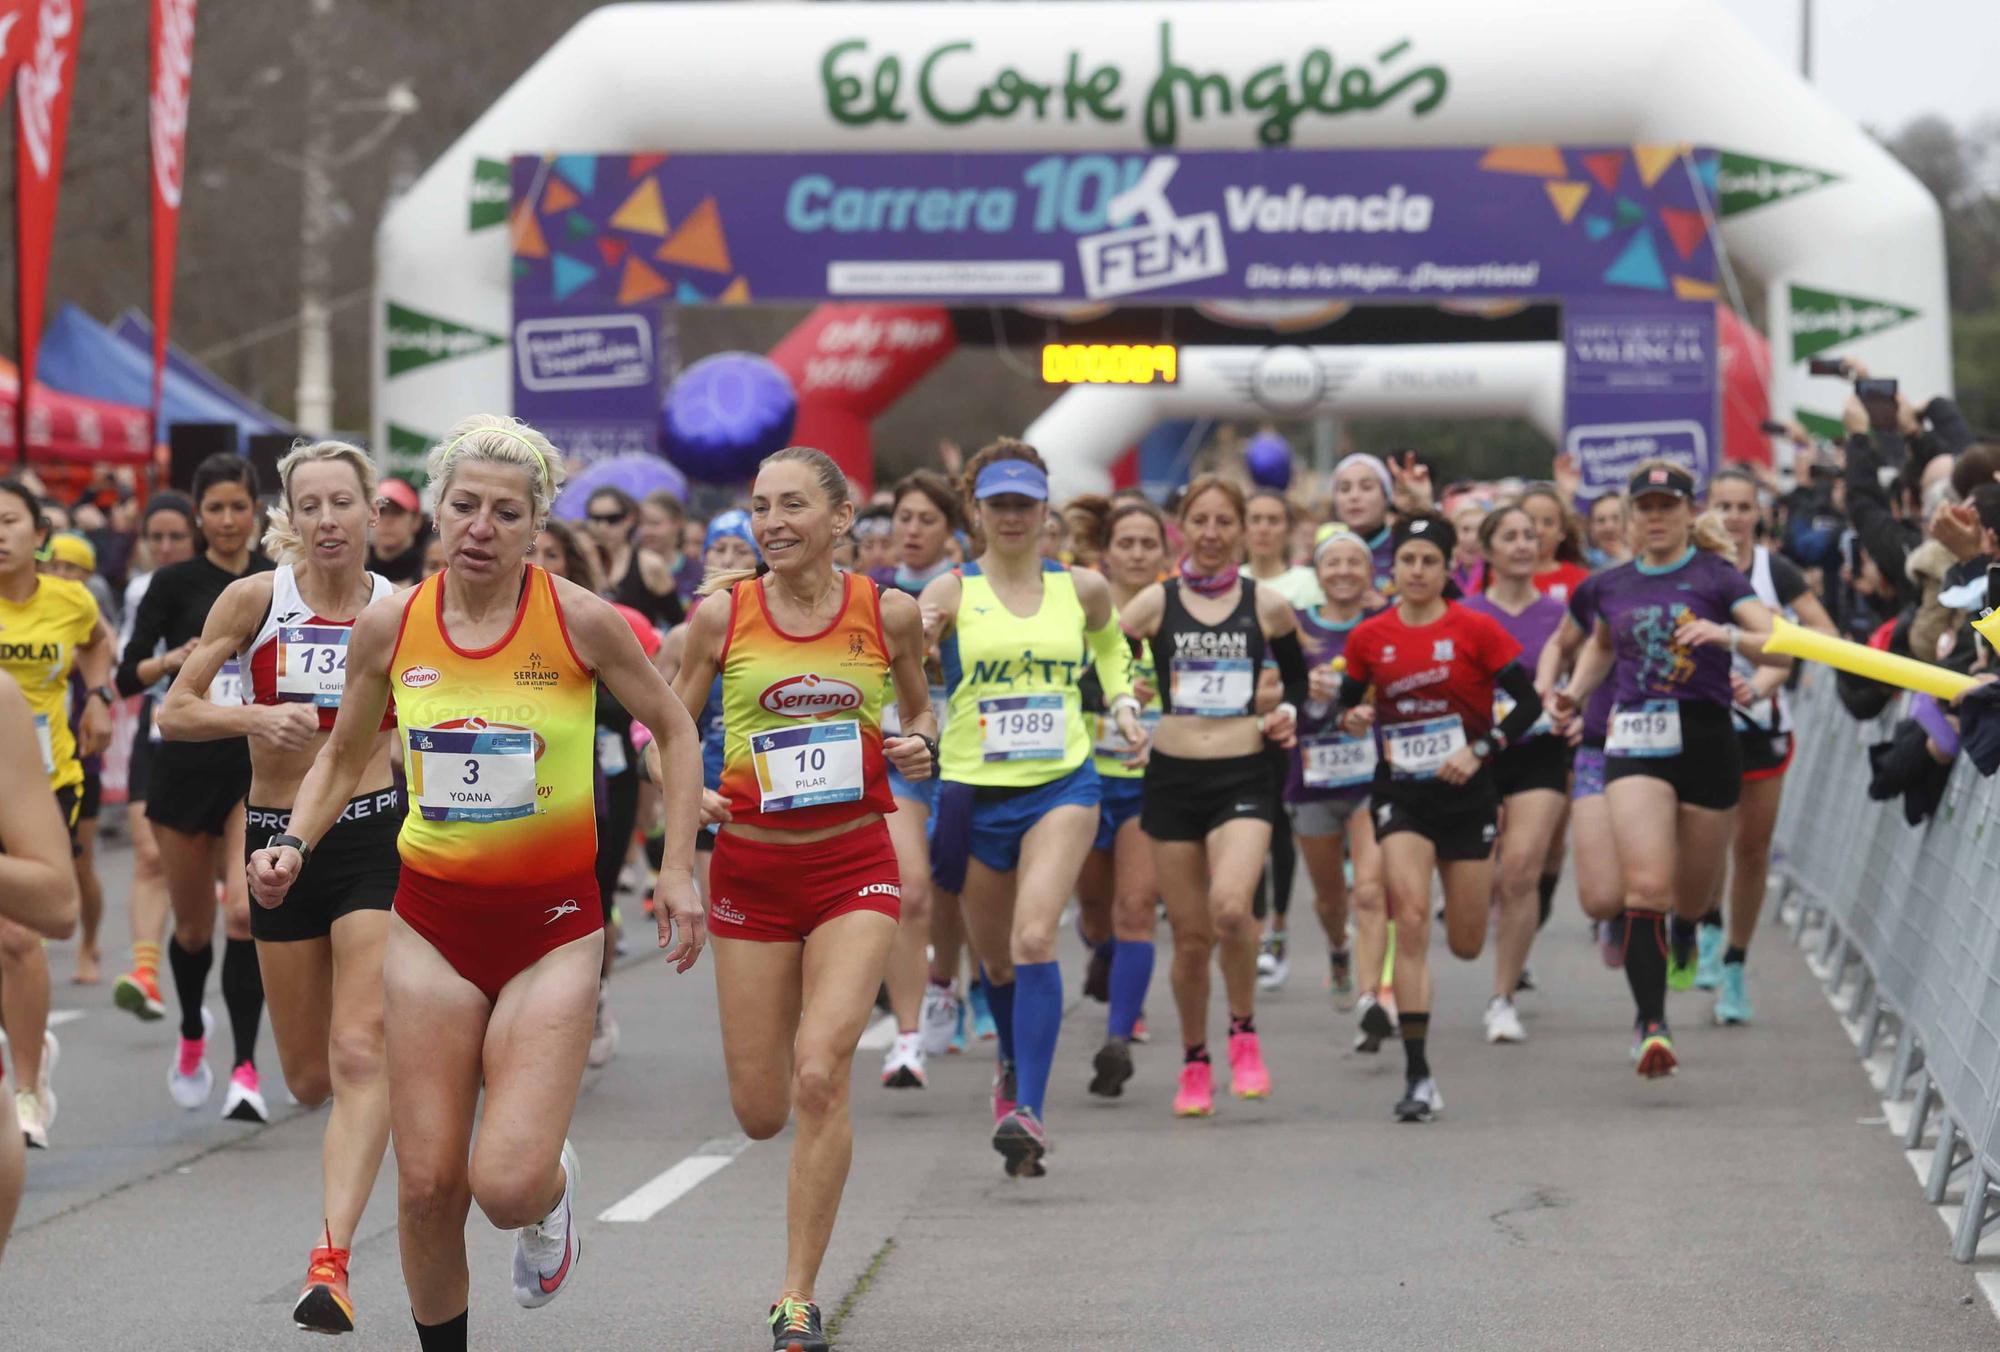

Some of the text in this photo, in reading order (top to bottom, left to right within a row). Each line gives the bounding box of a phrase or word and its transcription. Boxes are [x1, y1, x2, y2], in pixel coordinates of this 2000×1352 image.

[820, 20, 1449, 148] El Corte Inglés
[785, 173, 1016, 233] Carrera
[1225, 184, 1434, 233] Valencia
[1092, 222, 1213, 291] FEM
[1173, 631, 1247, 649] VEGAN
[403, 671, 437, 683] Serrano
[513, 671, 559, 680] SERRANO
[1200, 674, 1225, 694] 21
[771, 690, 855, 710] Serrano
[996, 712, 1054, 735] 1989
[1402, 733, 1452, 758] 1023
[795, 748, 825, 773] 10
[462, 759, 480, 785] 3
[795, 777, 826, 788] PILAR
[450, 792, 491, 802] YOANA
[535, 782, 553, 799] oy
